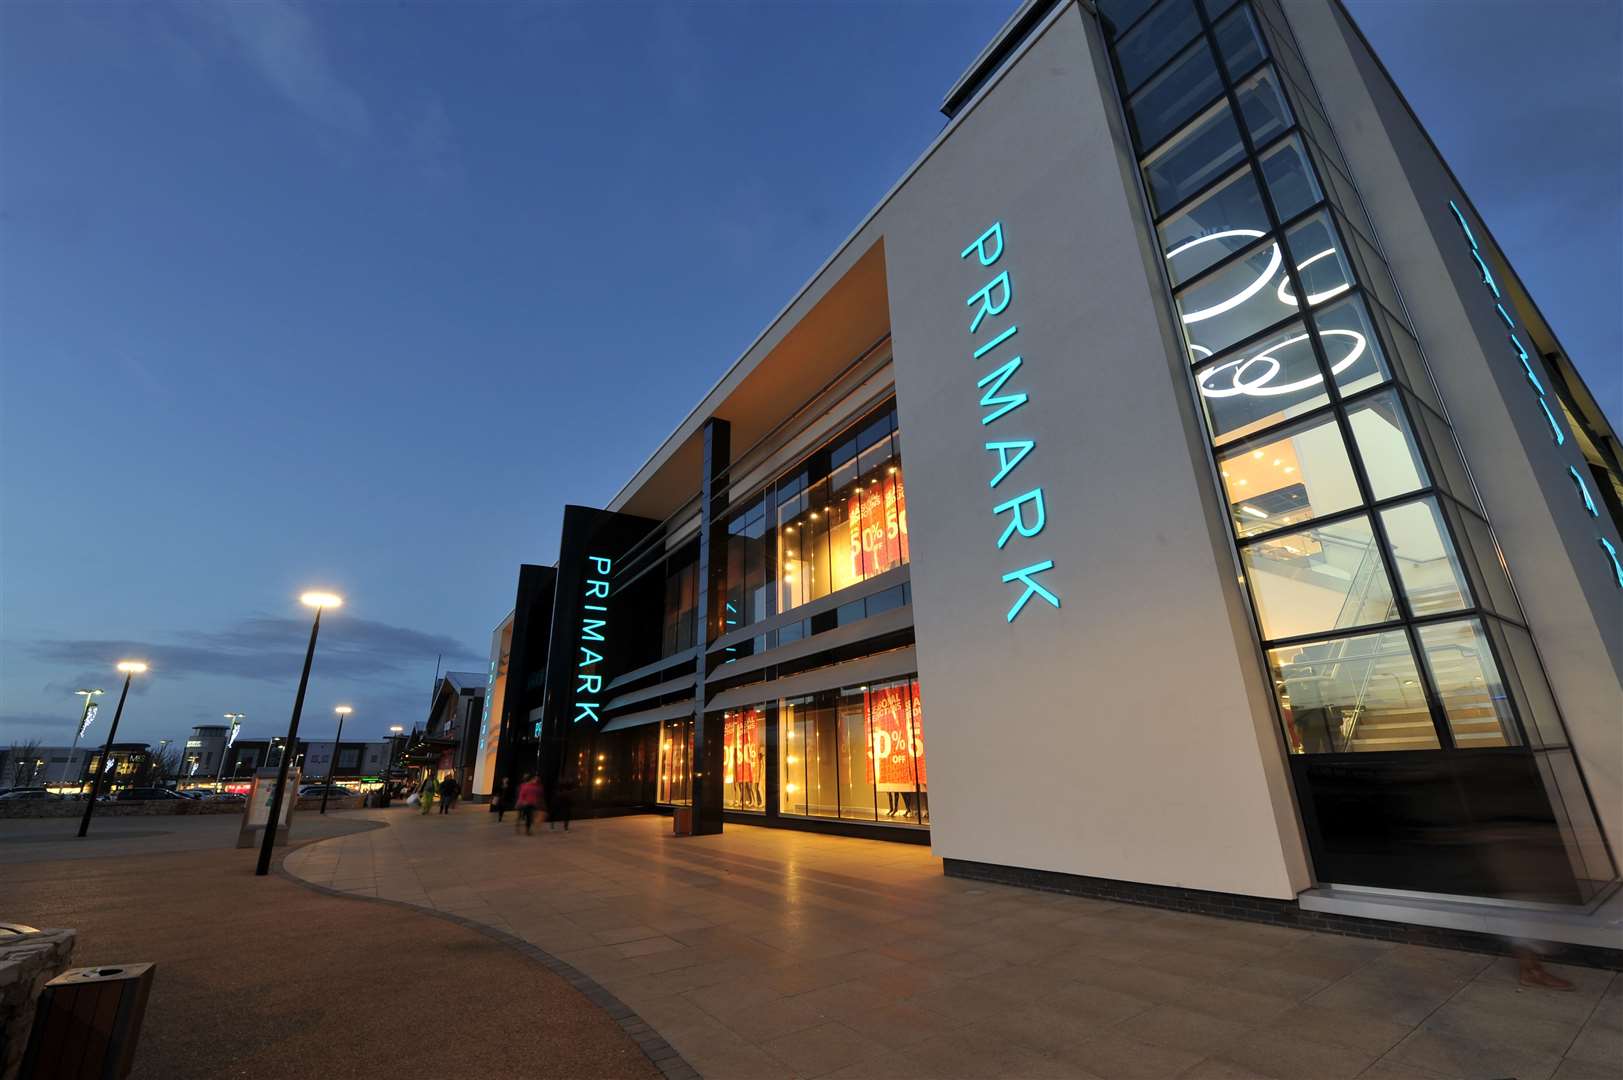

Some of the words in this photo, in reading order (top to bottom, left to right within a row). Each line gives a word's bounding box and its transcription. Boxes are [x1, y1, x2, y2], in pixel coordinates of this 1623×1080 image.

[960, 221, 1061, 624] PRIMARK
[574, 556, 612, 724] PRIMARK
[867, 728, 906, 760] 50%
[892, 755, 906, 764] OFF
